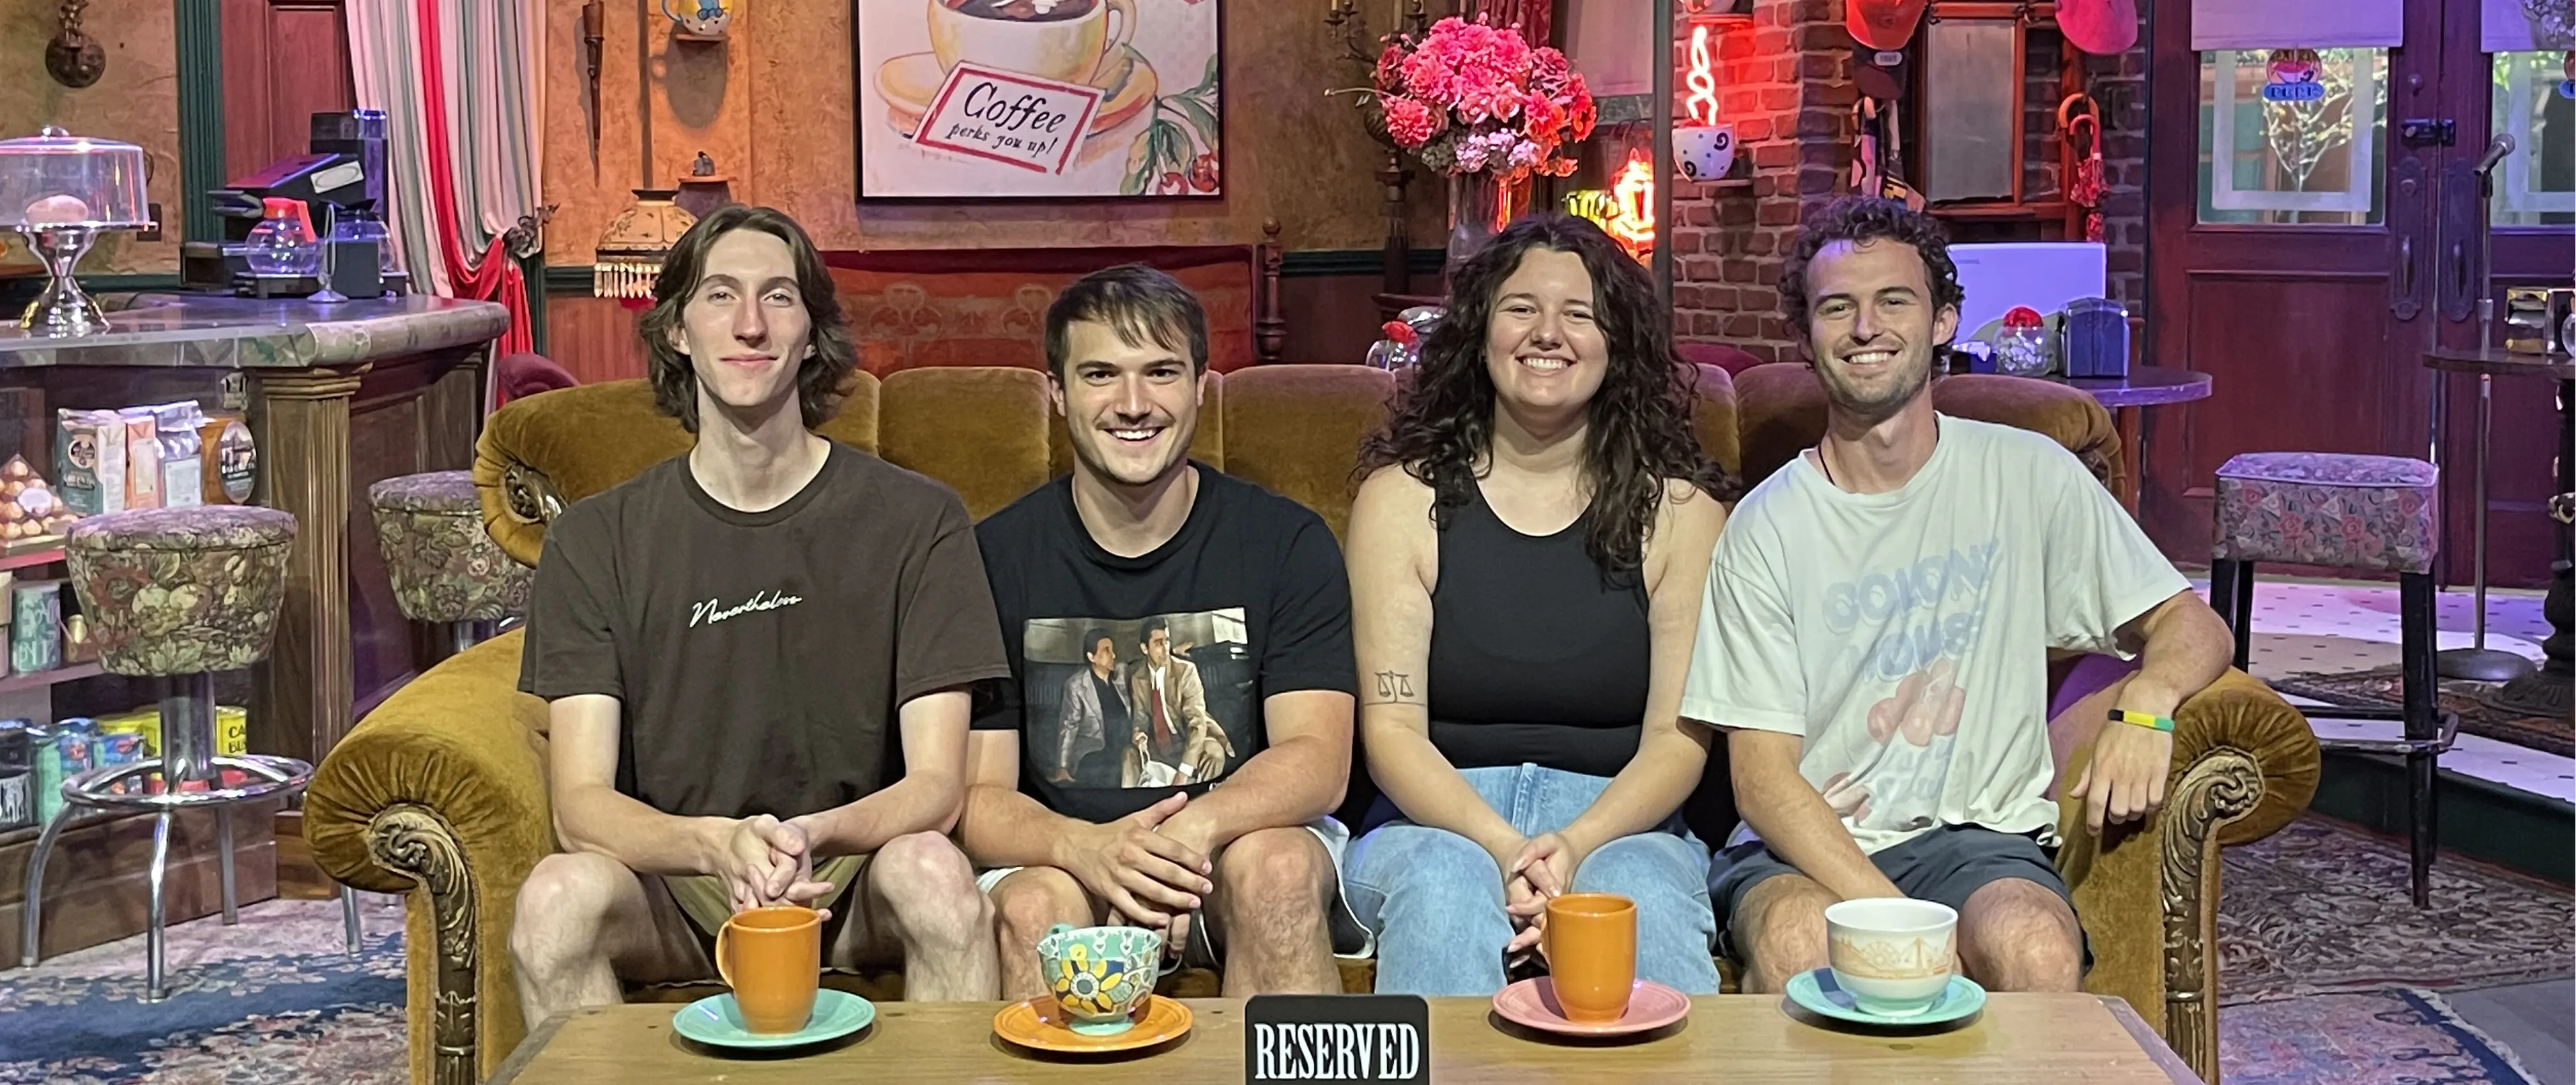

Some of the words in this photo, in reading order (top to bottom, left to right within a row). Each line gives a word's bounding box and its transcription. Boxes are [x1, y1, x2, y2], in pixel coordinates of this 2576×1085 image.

[964, 82, 1066, 133] Coffee
[944, 123, 991, 142] perks
[992, 133, 1022, 149] you
[1027, 137, 1058, 158] up!
[1254, 1023, 1420, 1080] RESERVED
